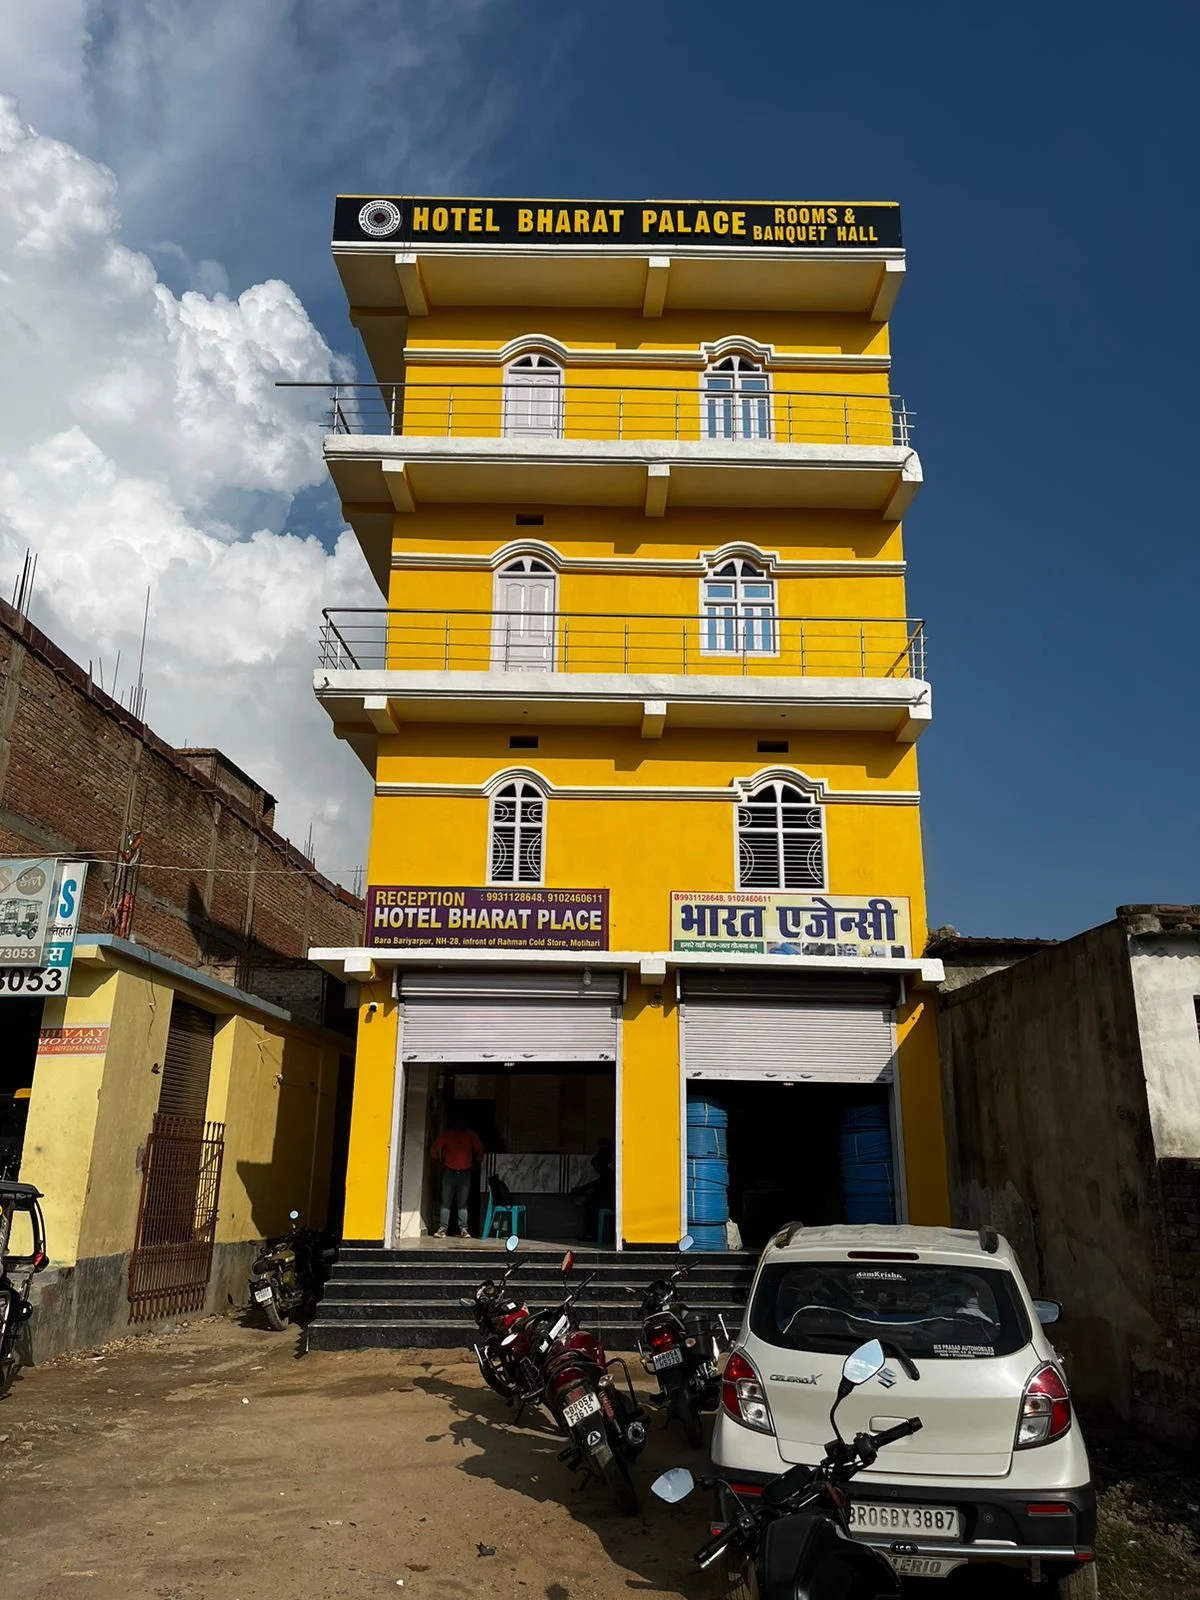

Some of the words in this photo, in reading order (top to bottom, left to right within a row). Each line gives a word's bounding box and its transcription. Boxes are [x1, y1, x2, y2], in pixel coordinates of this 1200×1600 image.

[412, 207, 500, 232] HOTEL
[517, 208, 625, 234] BHARAT
[642, 209, 747, 235] PALACE
[774, 207, 838, 225] ROOMS
[844, 208, 856, 224] &
[752, 225, 828, 242] BANQUET
[837, 226, 878, 242] HALL
[375, 891, 465, 907] RECEPTION
[487, 892, 545, 903] 9931128648,
[547, 893, 603, 903] 9102460611
[680, 894, 727, 903] 9931128648,
[728, 895, 771, 903] 9102460611
[374, 907, 442, 928] HOTEL
[447, 908, 532, 930] BHARAT
[537, 909, 602, 931] PLACE
[681, 903, 766, 938] भारत
[776, 896, 899, 941] एजेन्सी
[374, 936, 392, 945] Bara
[393, 937, 434, 947] Bariyarpur,
[435, 937, 461, 946] NH-28,
[463, 937, 487, 946] infront
[488, 938, 496, 946] of
[498, 938, 527, 947] Rahman
[529, 938, 545, 947] Cold
[547, 938, 569, 948] Store,
[570, 939, 601, 948] Motihari
[38, 1036, 102, 1045] MOTORS
[39, 1028, 106, 1038] SHIVAAY
[568, 1394, 594, 1415] BR05A
[568, 1403, 594, 1424] F3615
[848, 1506, 955, 1531] BR06BX3887
[892, 1558, 942, 1574] LERIO
